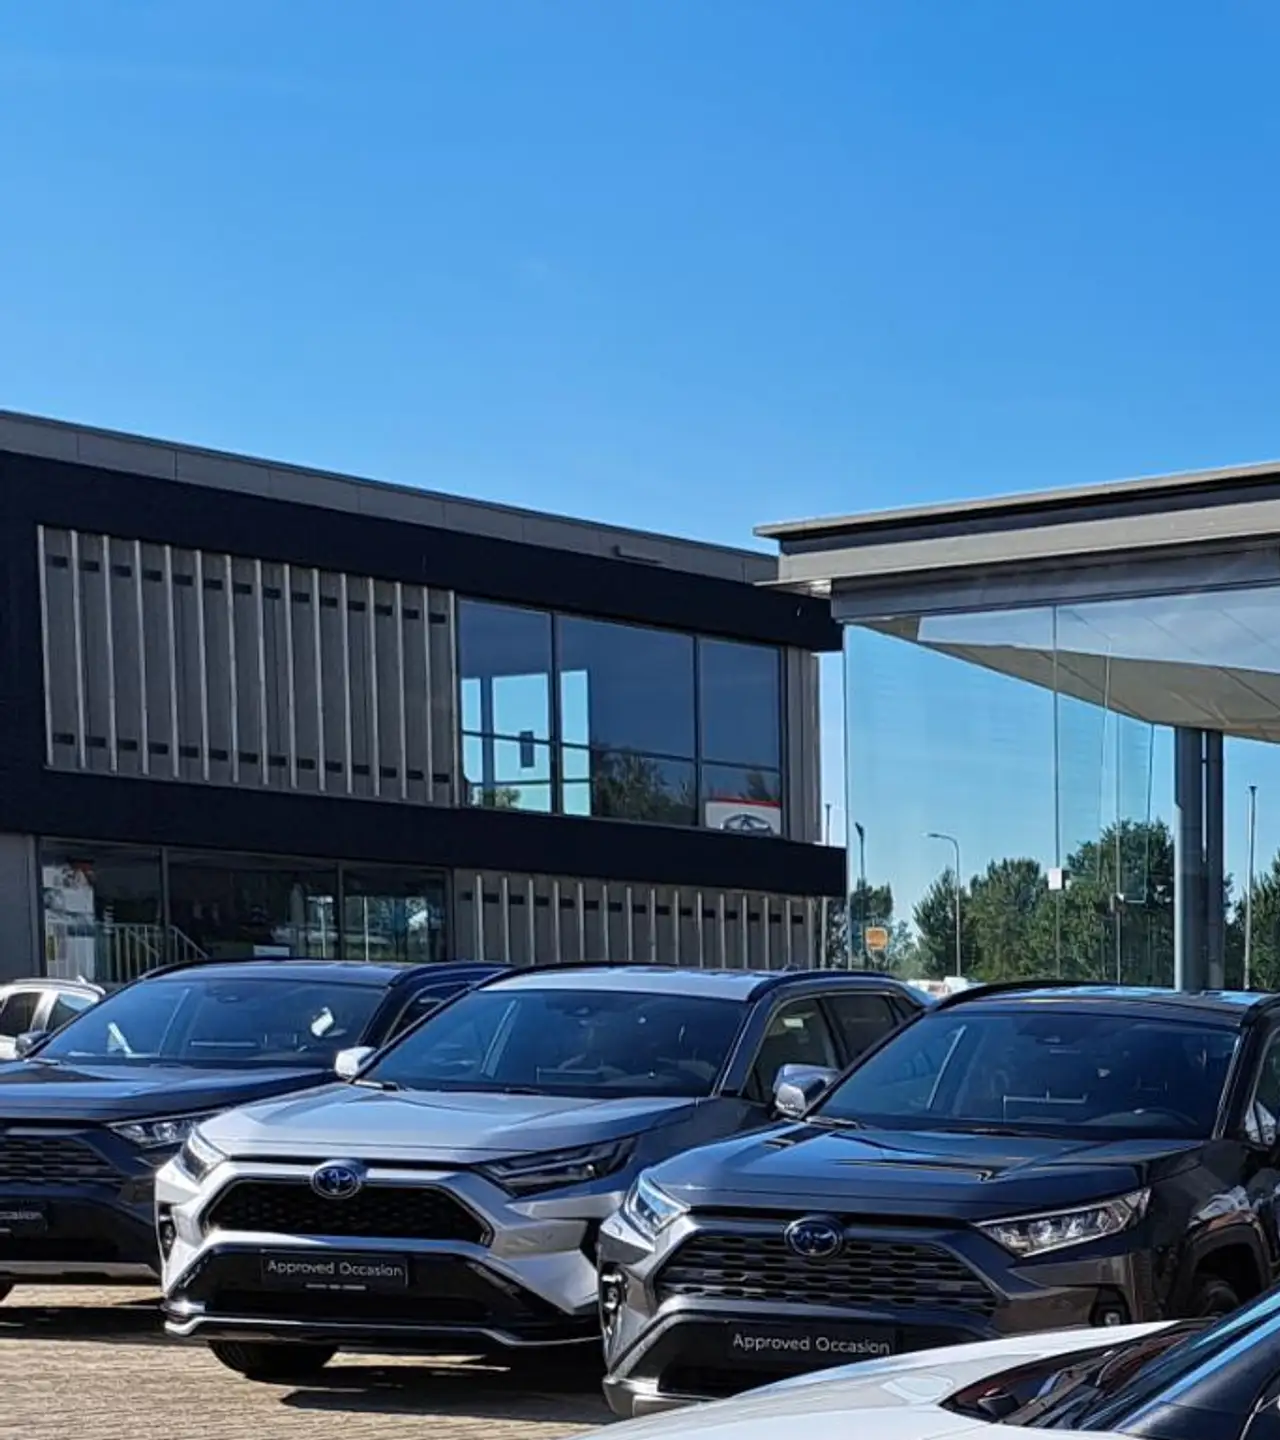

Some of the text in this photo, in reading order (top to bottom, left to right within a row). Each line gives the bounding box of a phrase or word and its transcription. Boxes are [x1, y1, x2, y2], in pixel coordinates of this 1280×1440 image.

[267, 1260, 403, 1277] Approved Occasion
[733, 1334, 890, 1355] Approved Occasion
